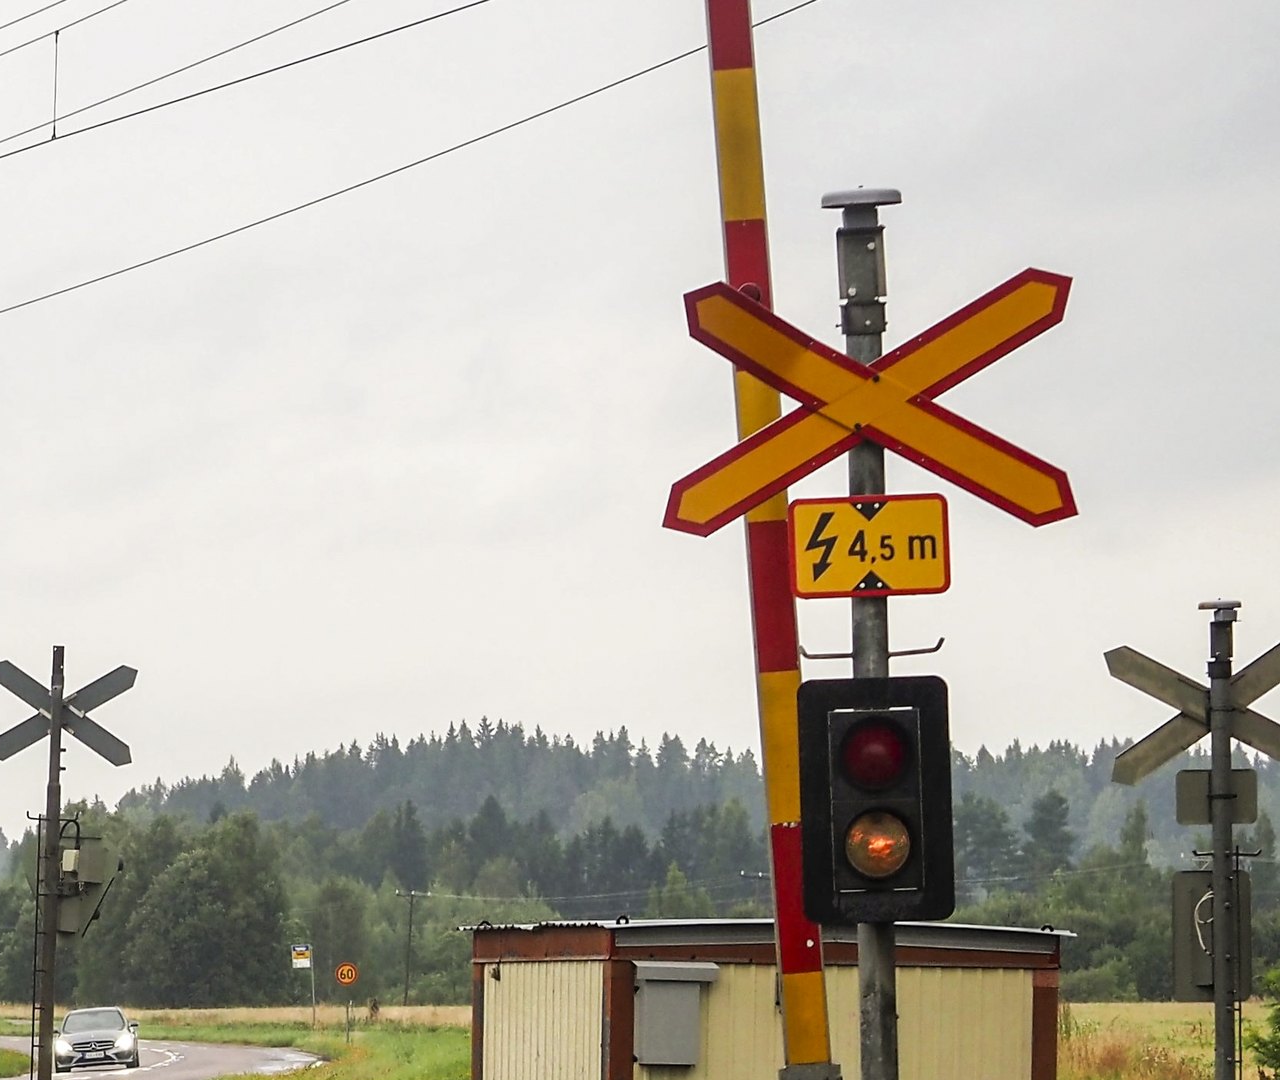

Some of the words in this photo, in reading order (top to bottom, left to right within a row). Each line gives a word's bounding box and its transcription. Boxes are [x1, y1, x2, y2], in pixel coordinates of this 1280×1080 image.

[848, 530, 895, 564] 4,5
[908, 534, 937, 560] m
[340, 968, 354, 980] 60
